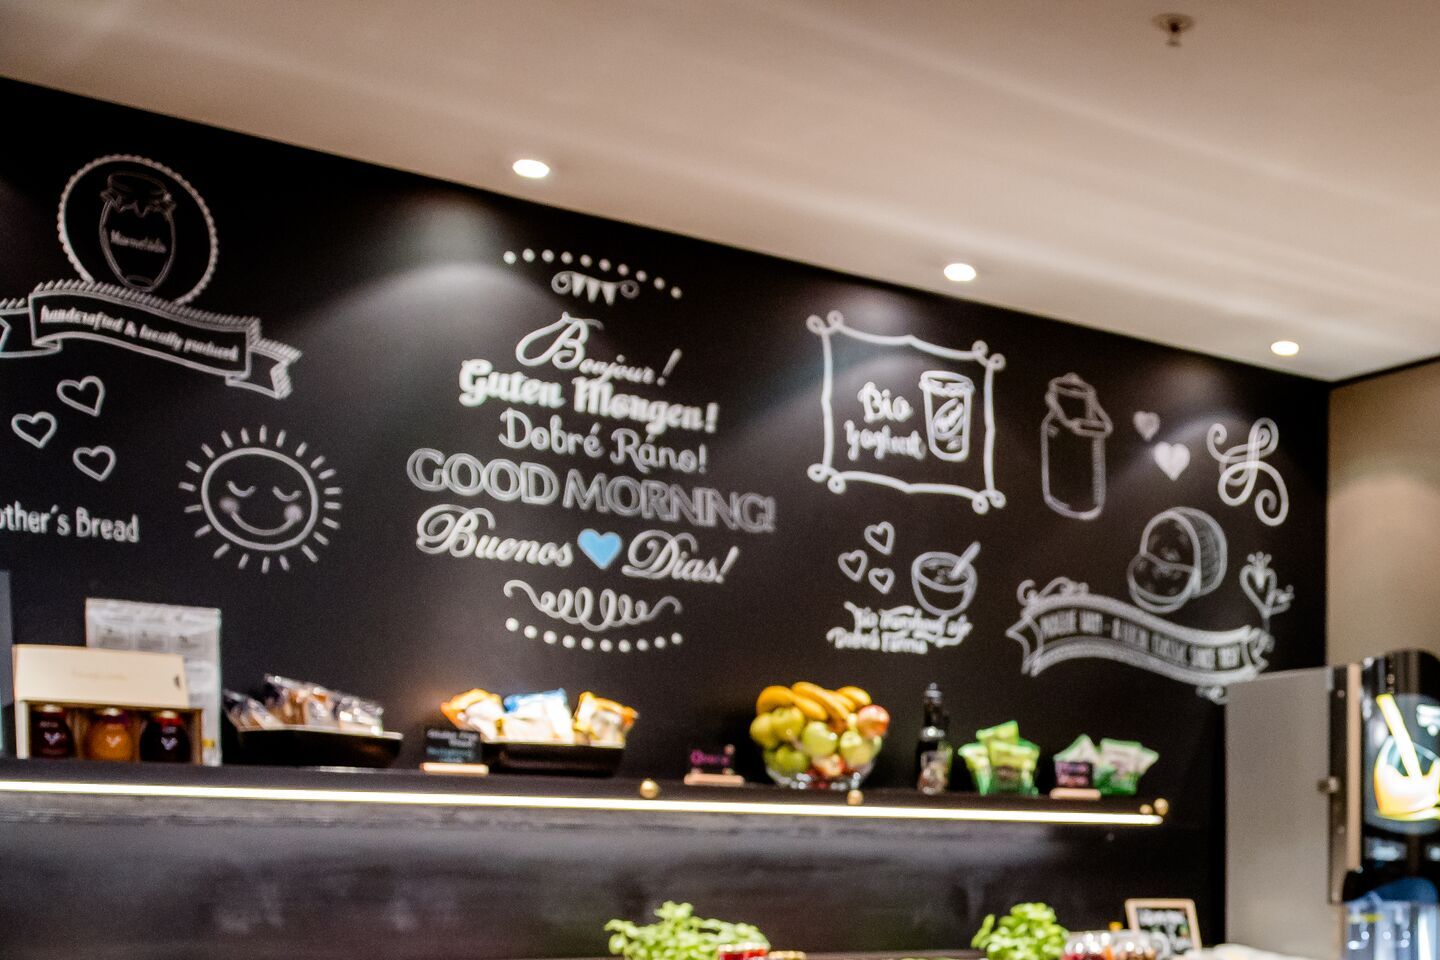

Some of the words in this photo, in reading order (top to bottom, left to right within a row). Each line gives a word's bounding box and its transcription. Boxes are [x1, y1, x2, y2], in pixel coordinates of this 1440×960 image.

[458, 359, 566, 407] Guten
[571, 376, 720, 435] Morgen!
[857, 382, 913, 423] Bio
[498, 407, 604, 457] Dobré
[610, 427, 708, 474] Ráno!
[406, 447, 560, 505] GOOD
[76, 506, 140, 543] Bread
[415, 503, 574, 567] Buenos
